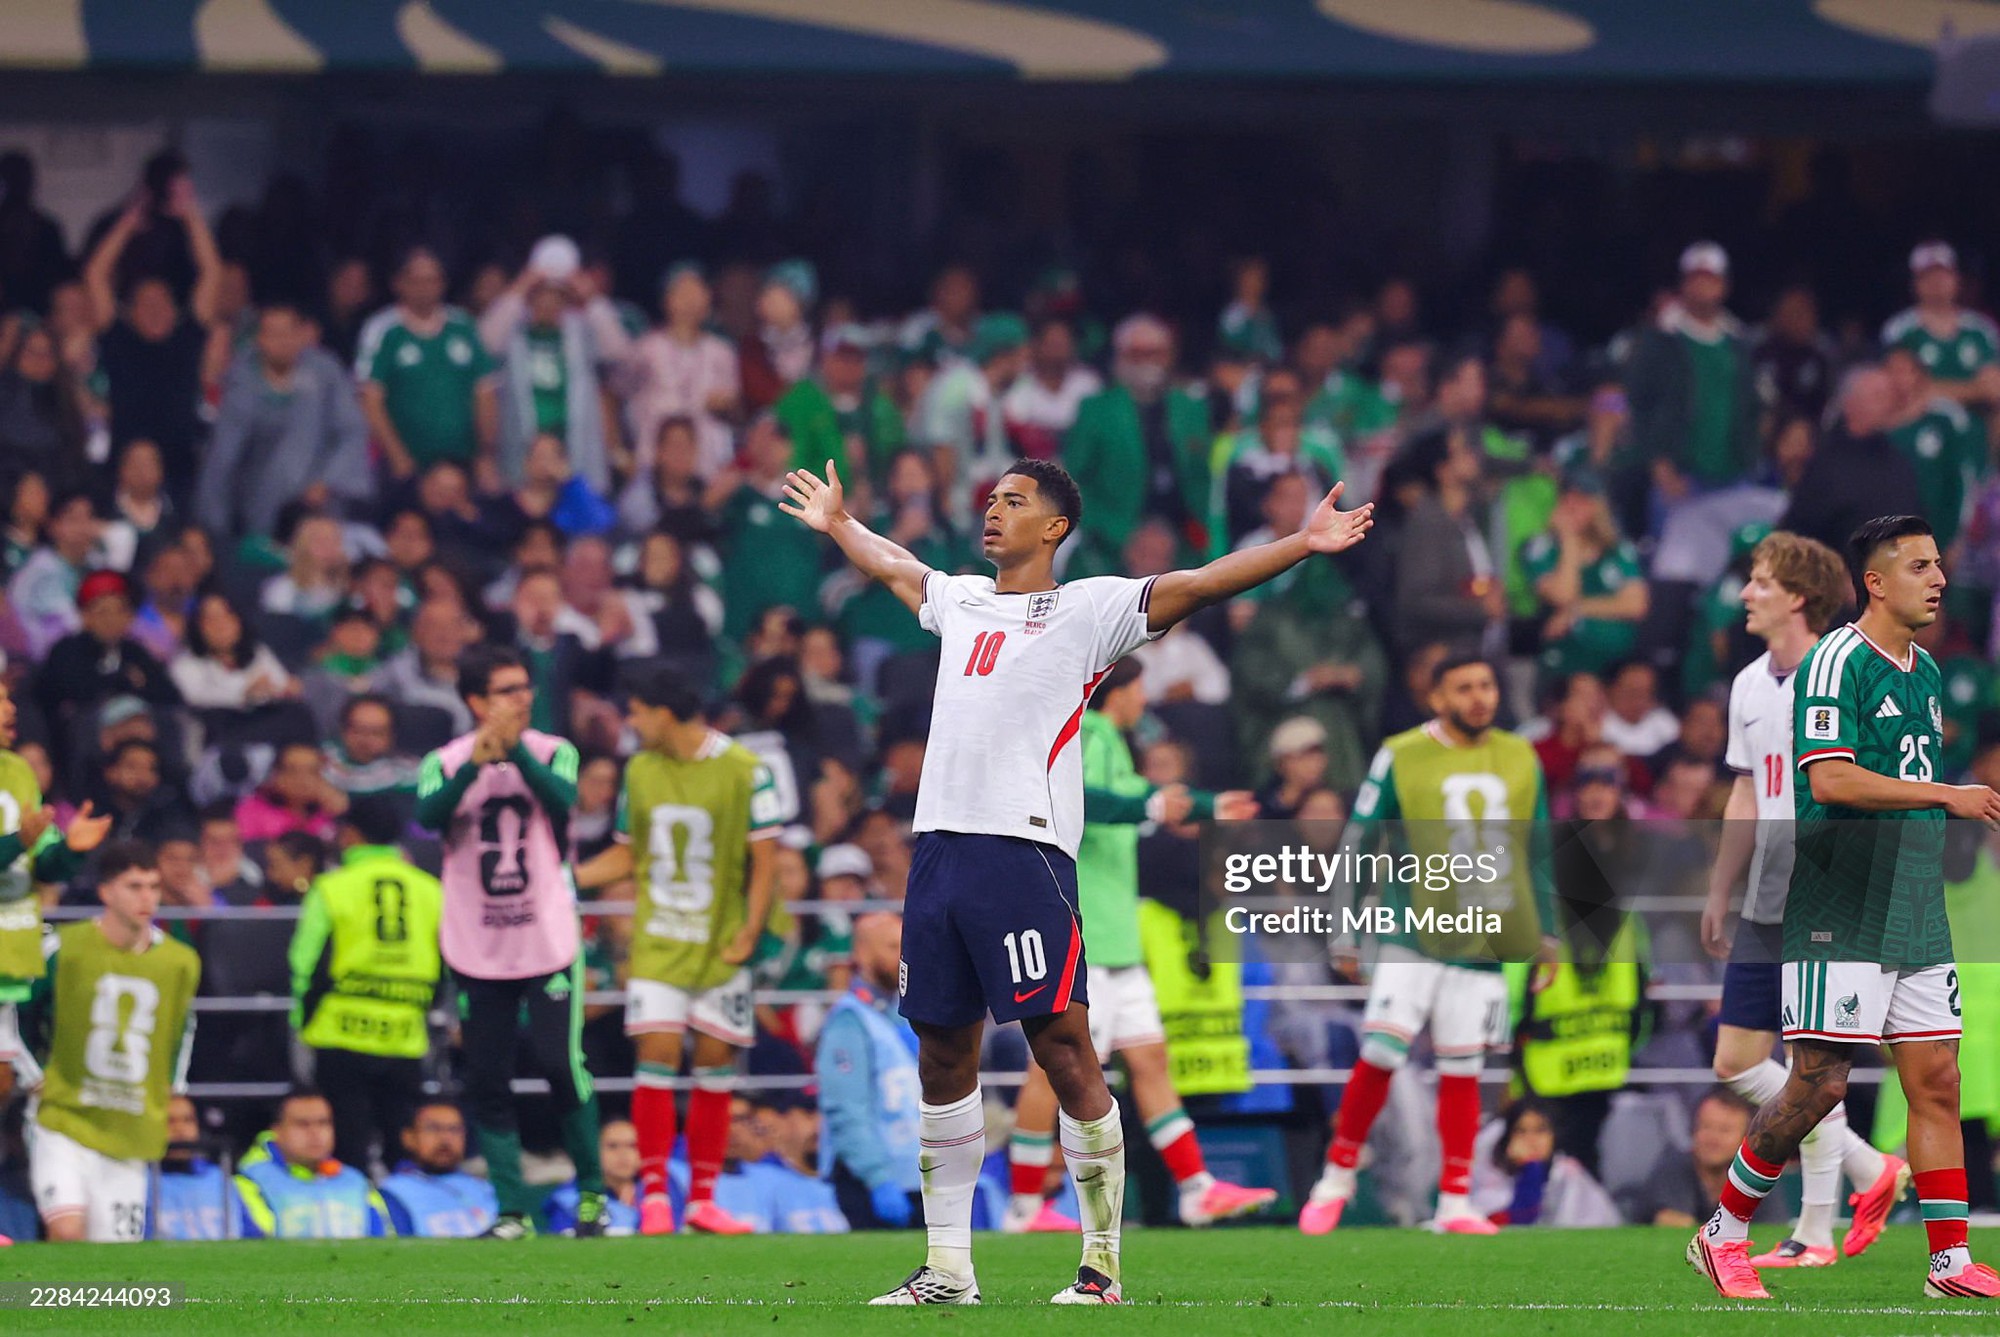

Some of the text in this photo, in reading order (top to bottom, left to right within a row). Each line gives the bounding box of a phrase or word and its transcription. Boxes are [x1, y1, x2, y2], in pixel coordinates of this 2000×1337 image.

[1025, 621, 1046, 629] MEXICO
[963, 631, 1007, 676] 10
[1765, 753, 1783, 798] 18
[1899, 734, 1933, 783] 25
[1003, 928, 1048, 984] 10
